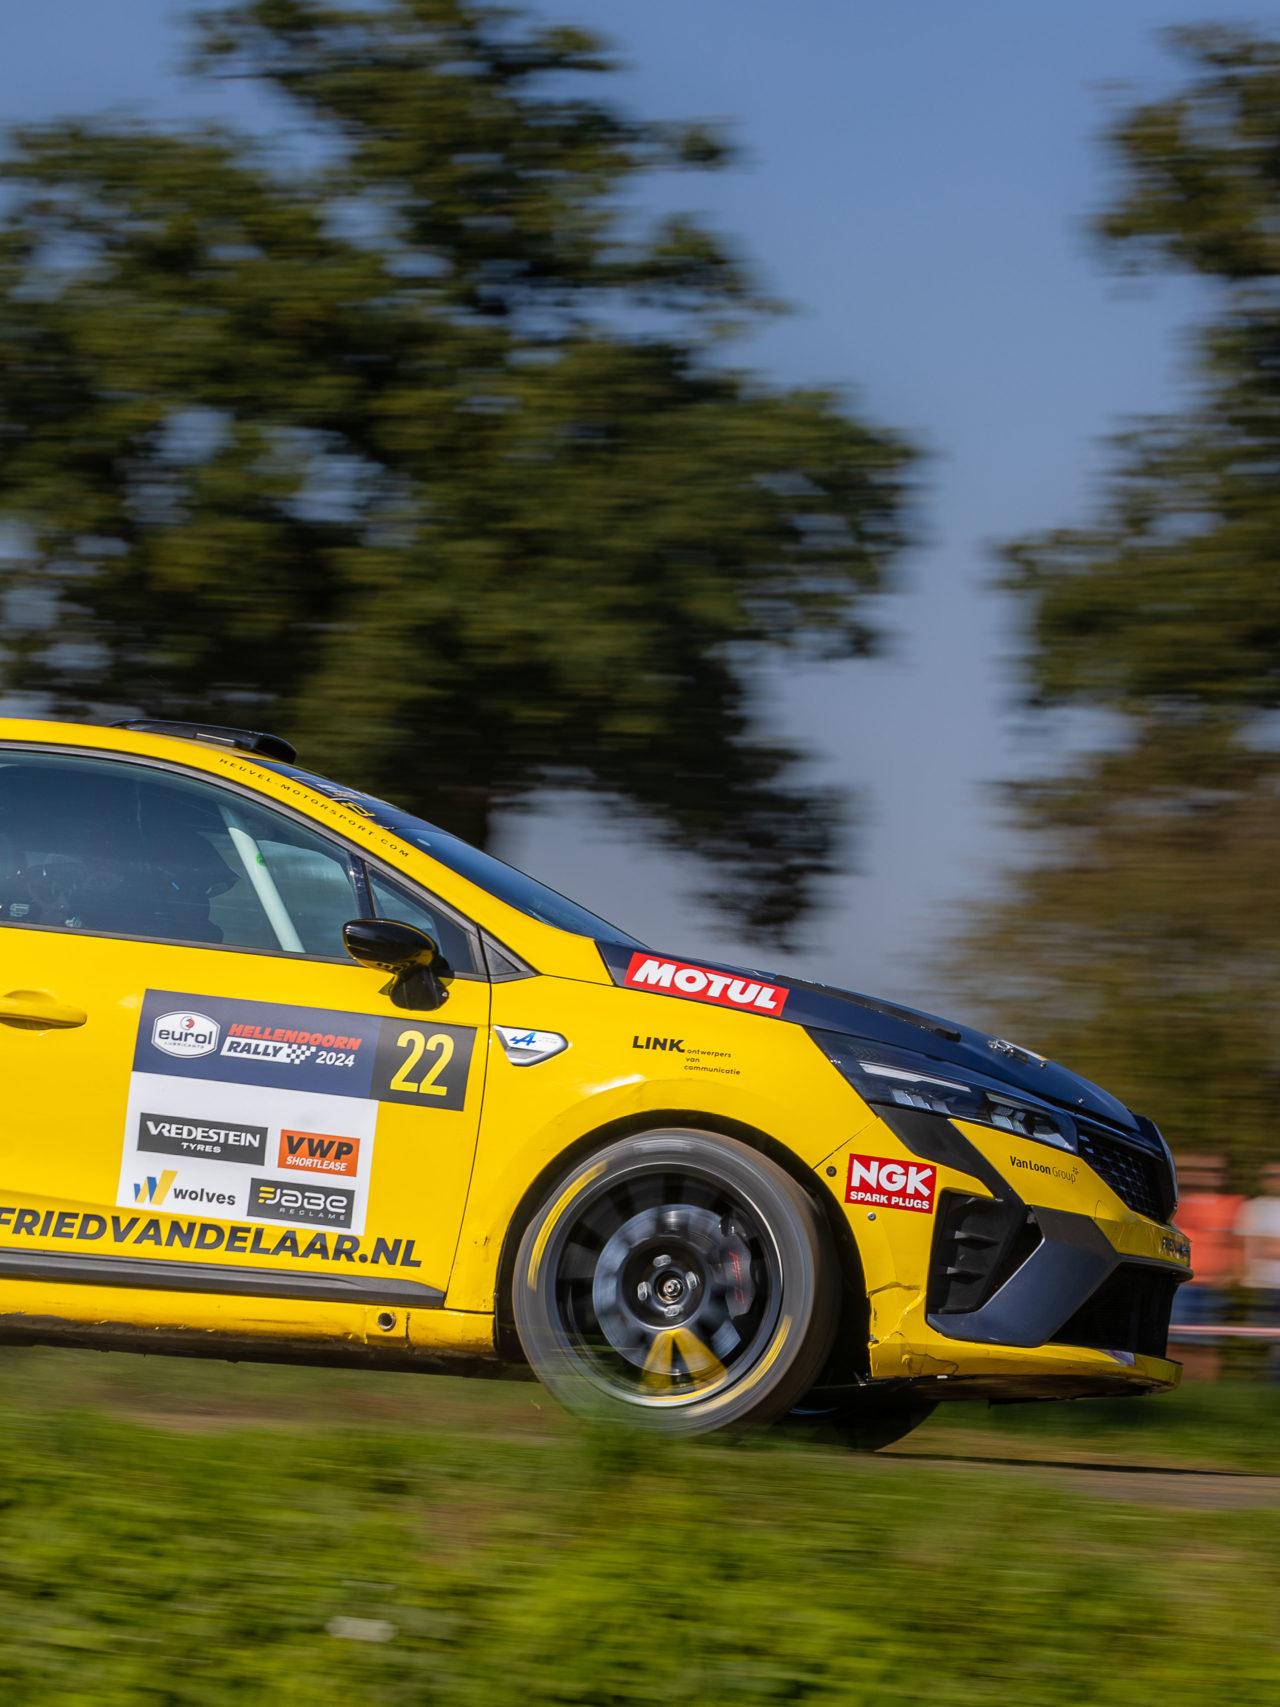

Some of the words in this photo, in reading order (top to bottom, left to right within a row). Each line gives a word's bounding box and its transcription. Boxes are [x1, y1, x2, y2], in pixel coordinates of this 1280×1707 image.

[631, 960, 779, 1010] MOTUL
[158, 1028, 213, 1045] eurol
[228, 1023, 363, 1050] HELLENDOORN
[632, 1035, 685, 1053] LINK
[687, 1048, 732, 1058] ontwerpers
[227, 1041, 284, 1058] RALLY
[315, 1051, 355, 1068] 2024
[389, 1030, 449, 1096] 22
[684, 1065, 741, 1075] communicatie
[146, 1121, 261, 1148] VREDESTEIN
[181, 1142, 221, 1153] TYRES
[286, 1135, 354, 1160] VWP
[286, 1156, 348, 1172] SHORTLEASE
[1010, 1155, 1028, 1169] Van
[1029, 1161, 1052, 1175] Loon
[1052, 1167, 1076, 1184] Group
[850, 1158, 933, 1197] NGK
[173, 1187, 236, 1206] wolves
[850, 1191, 888, 1204] SPARK
[891, 1196, 930, 1210] PLUGS
